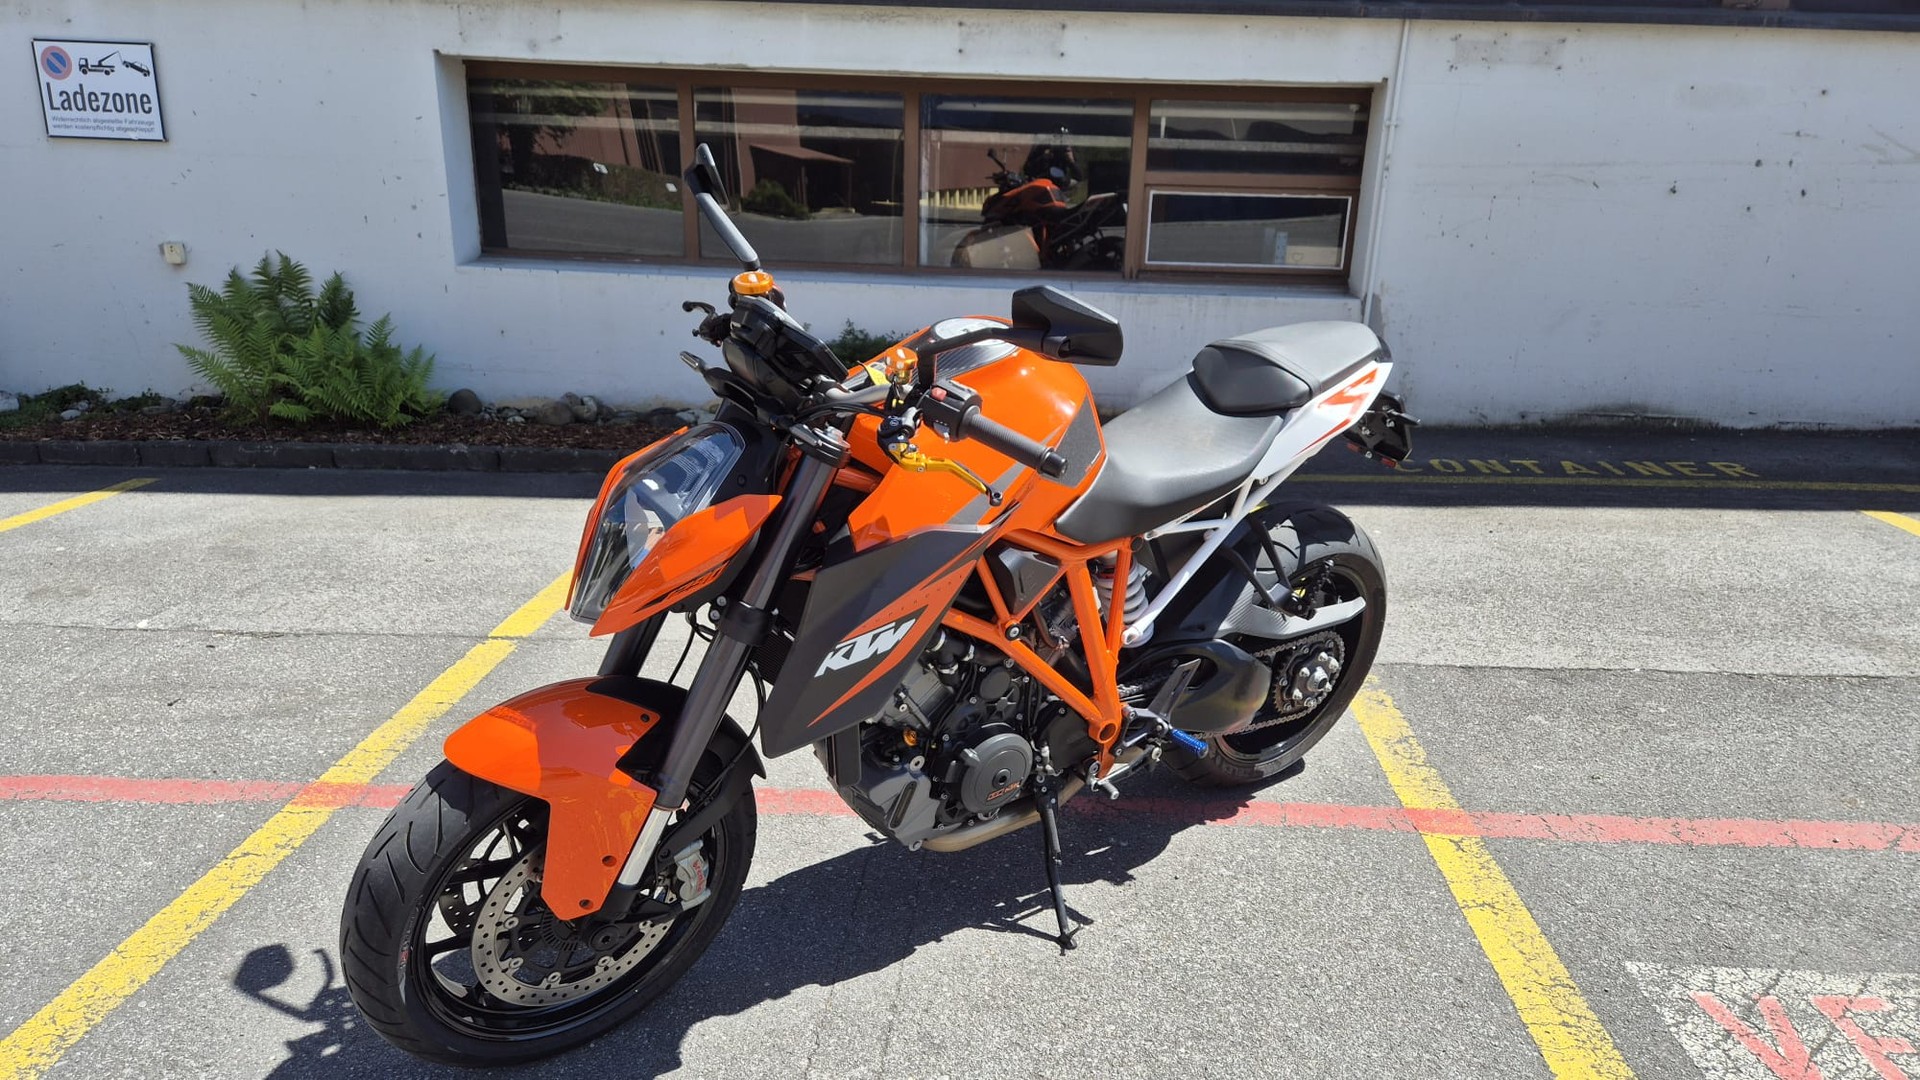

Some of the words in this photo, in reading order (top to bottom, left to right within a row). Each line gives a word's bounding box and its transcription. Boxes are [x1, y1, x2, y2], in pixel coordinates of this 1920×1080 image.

[46, 81, 152, 114] Ladezone
[1395, 458, 1760, 478] CONTAINER
[814, 618, 916, 678] KTM
